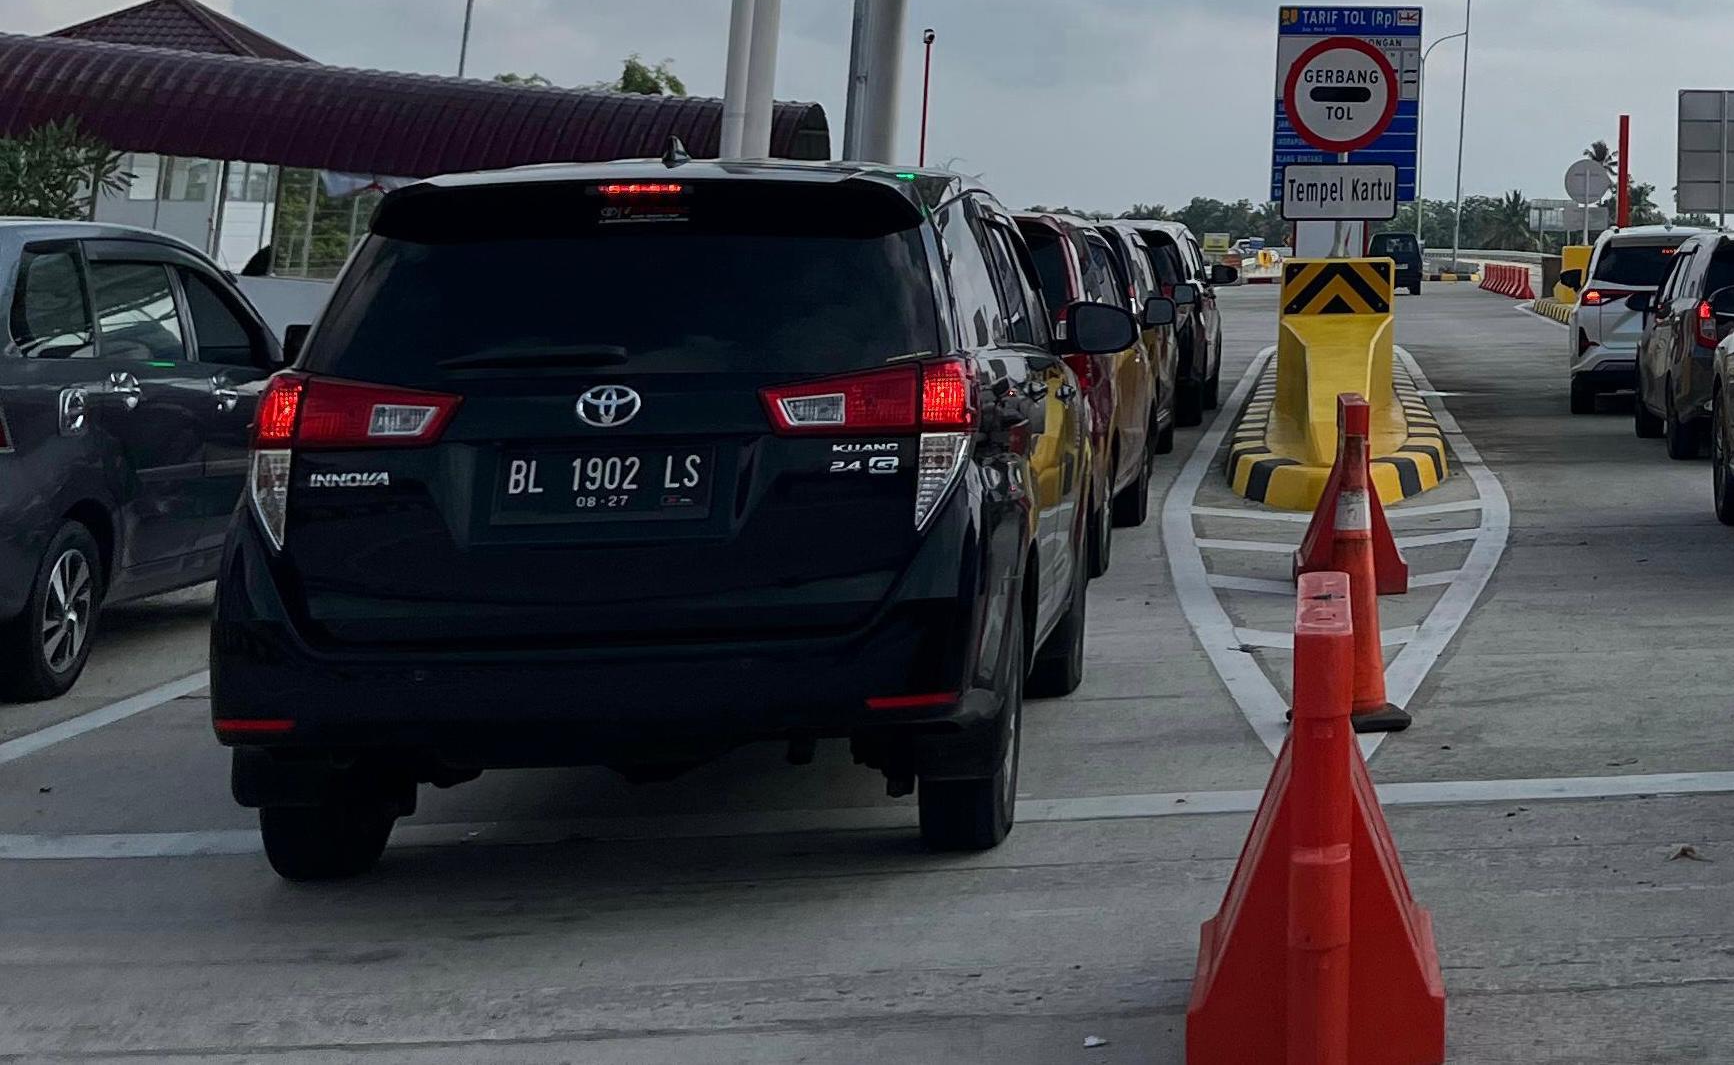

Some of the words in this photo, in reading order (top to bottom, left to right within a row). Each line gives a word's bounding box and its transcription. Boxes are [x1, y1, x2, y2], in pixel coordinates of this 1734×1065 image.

[1303, 10, 1338, 25] TARIF
[1343, 11, 1366, 25] TOL
[1371, 10, 1397, 29] (Rp)
[1303, 69, 1379, 84] GERBANG
[1325, 106, 1354, 121] TOL
[1288, 177, 1344, 208] Tempel
[1351, 178, 1393, 202] Kartu
[508, 460, 544, 494] BL
[572, 456, 641, 492] 1902
[664, 454, 701, 489] LS
[869, 456, 899, 474] G
[310, 472, 389, 487] INNOVA
